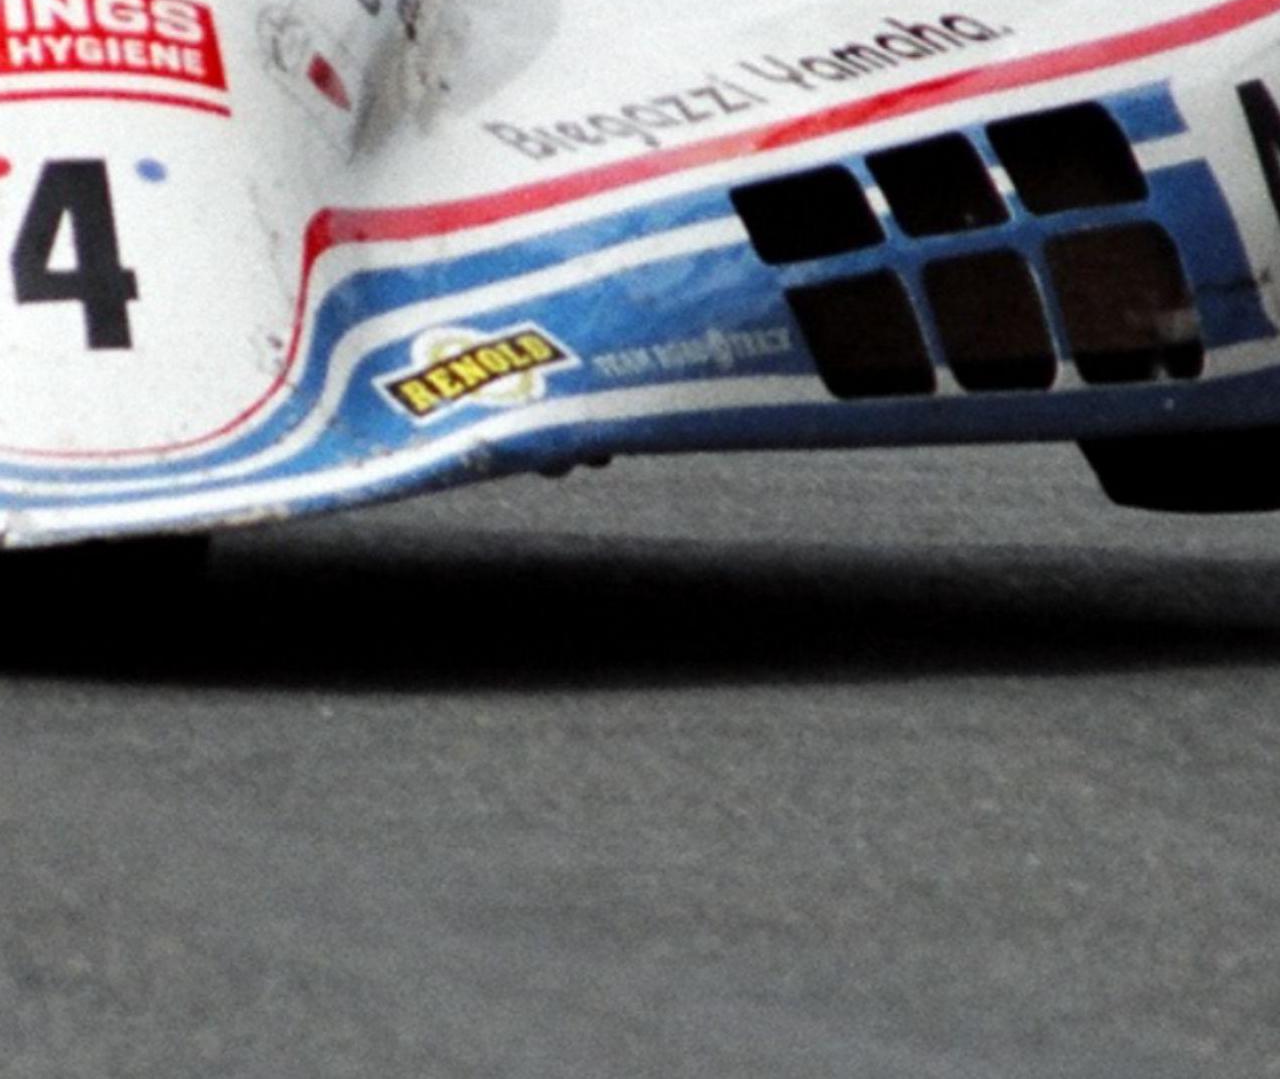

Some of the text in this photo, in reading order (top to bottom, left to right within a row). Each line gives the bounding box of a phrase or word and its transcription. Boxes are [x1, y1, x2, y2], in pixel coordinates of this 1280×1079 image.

[8, 34, 206, 77] HYGIENE
[10, 157, 139, 351] 4
[398, 334, 553, 414] RENOLD
